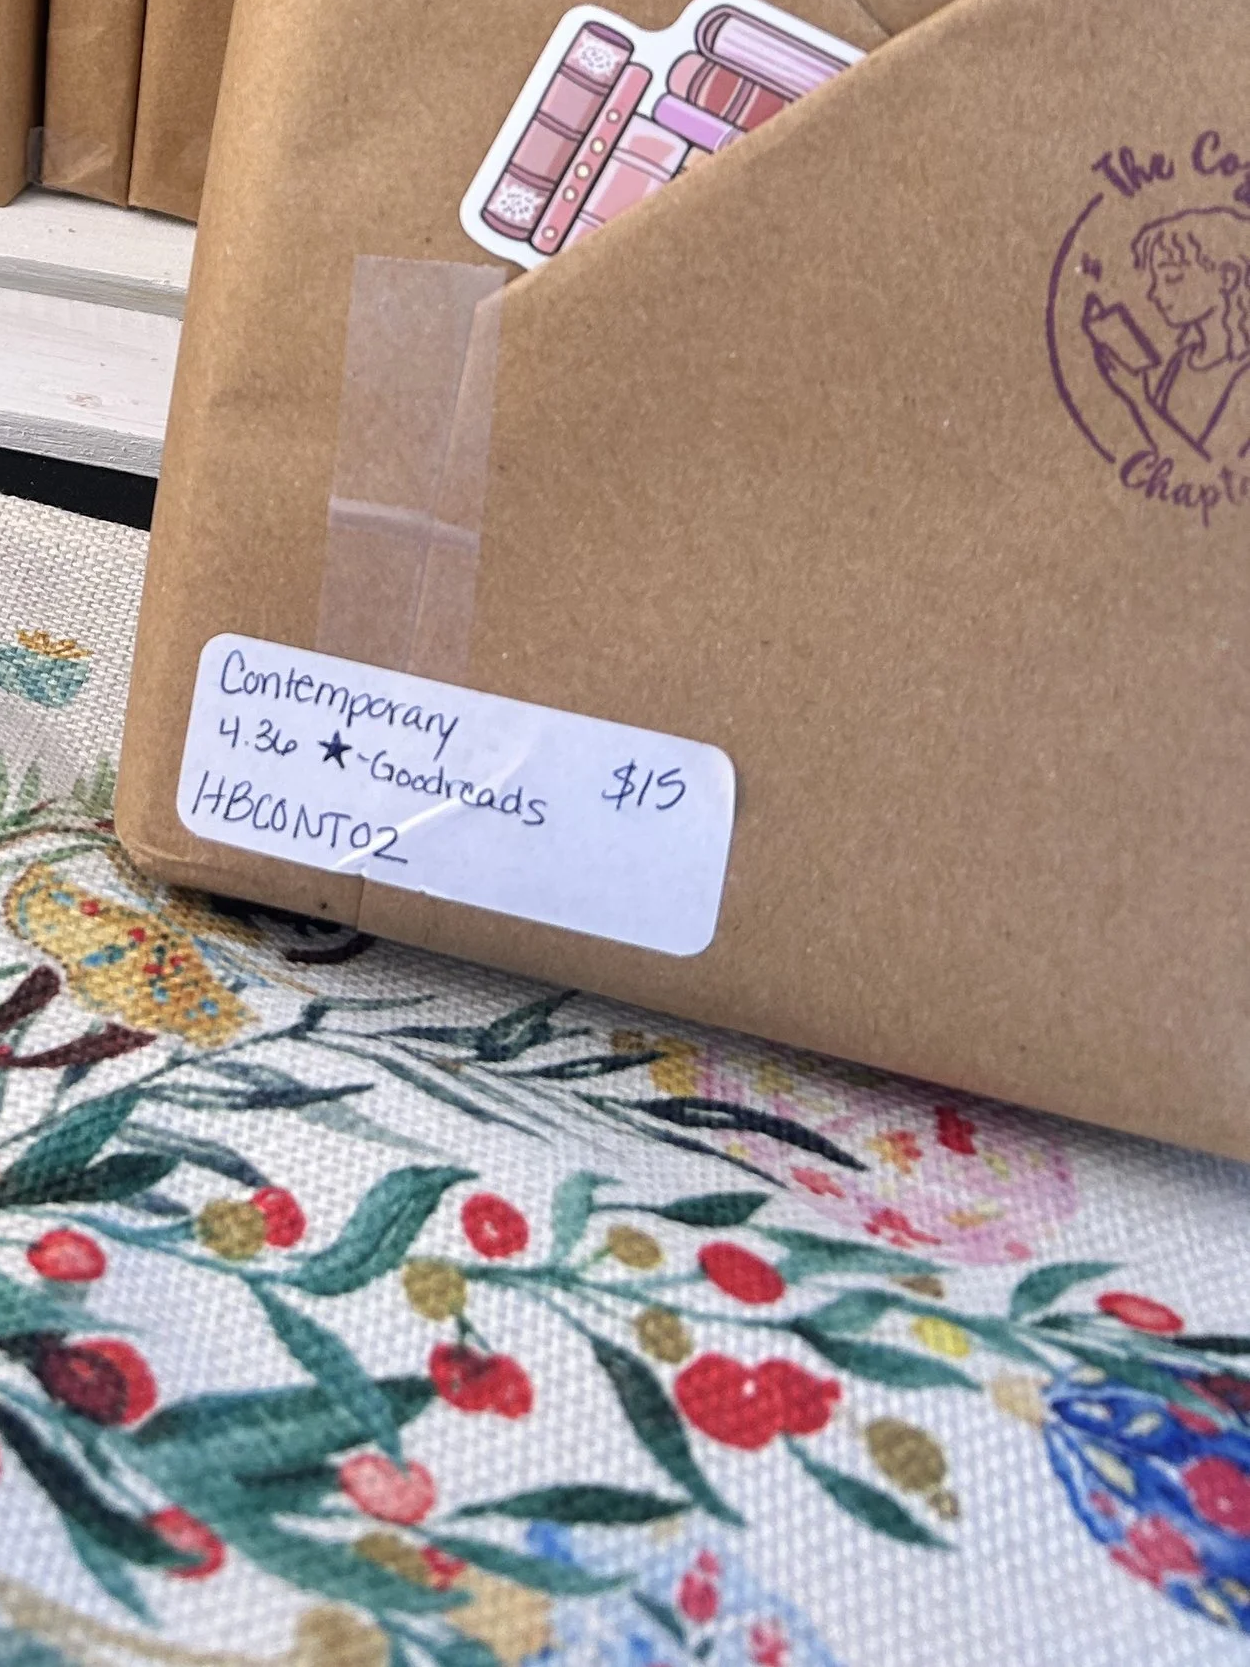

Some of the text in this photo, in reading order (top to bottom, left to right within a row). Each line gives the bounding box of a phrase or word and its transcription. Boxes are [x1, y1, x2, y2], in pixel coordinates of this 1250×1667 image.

[1091, 146, 1174, 198] The
[220, 649, 458, 760] Contemporary
[219, 717, 297, 756] 4.36
[602, 760, 686, 812] $15
[191, 770, 408, 864] HBCONT02
